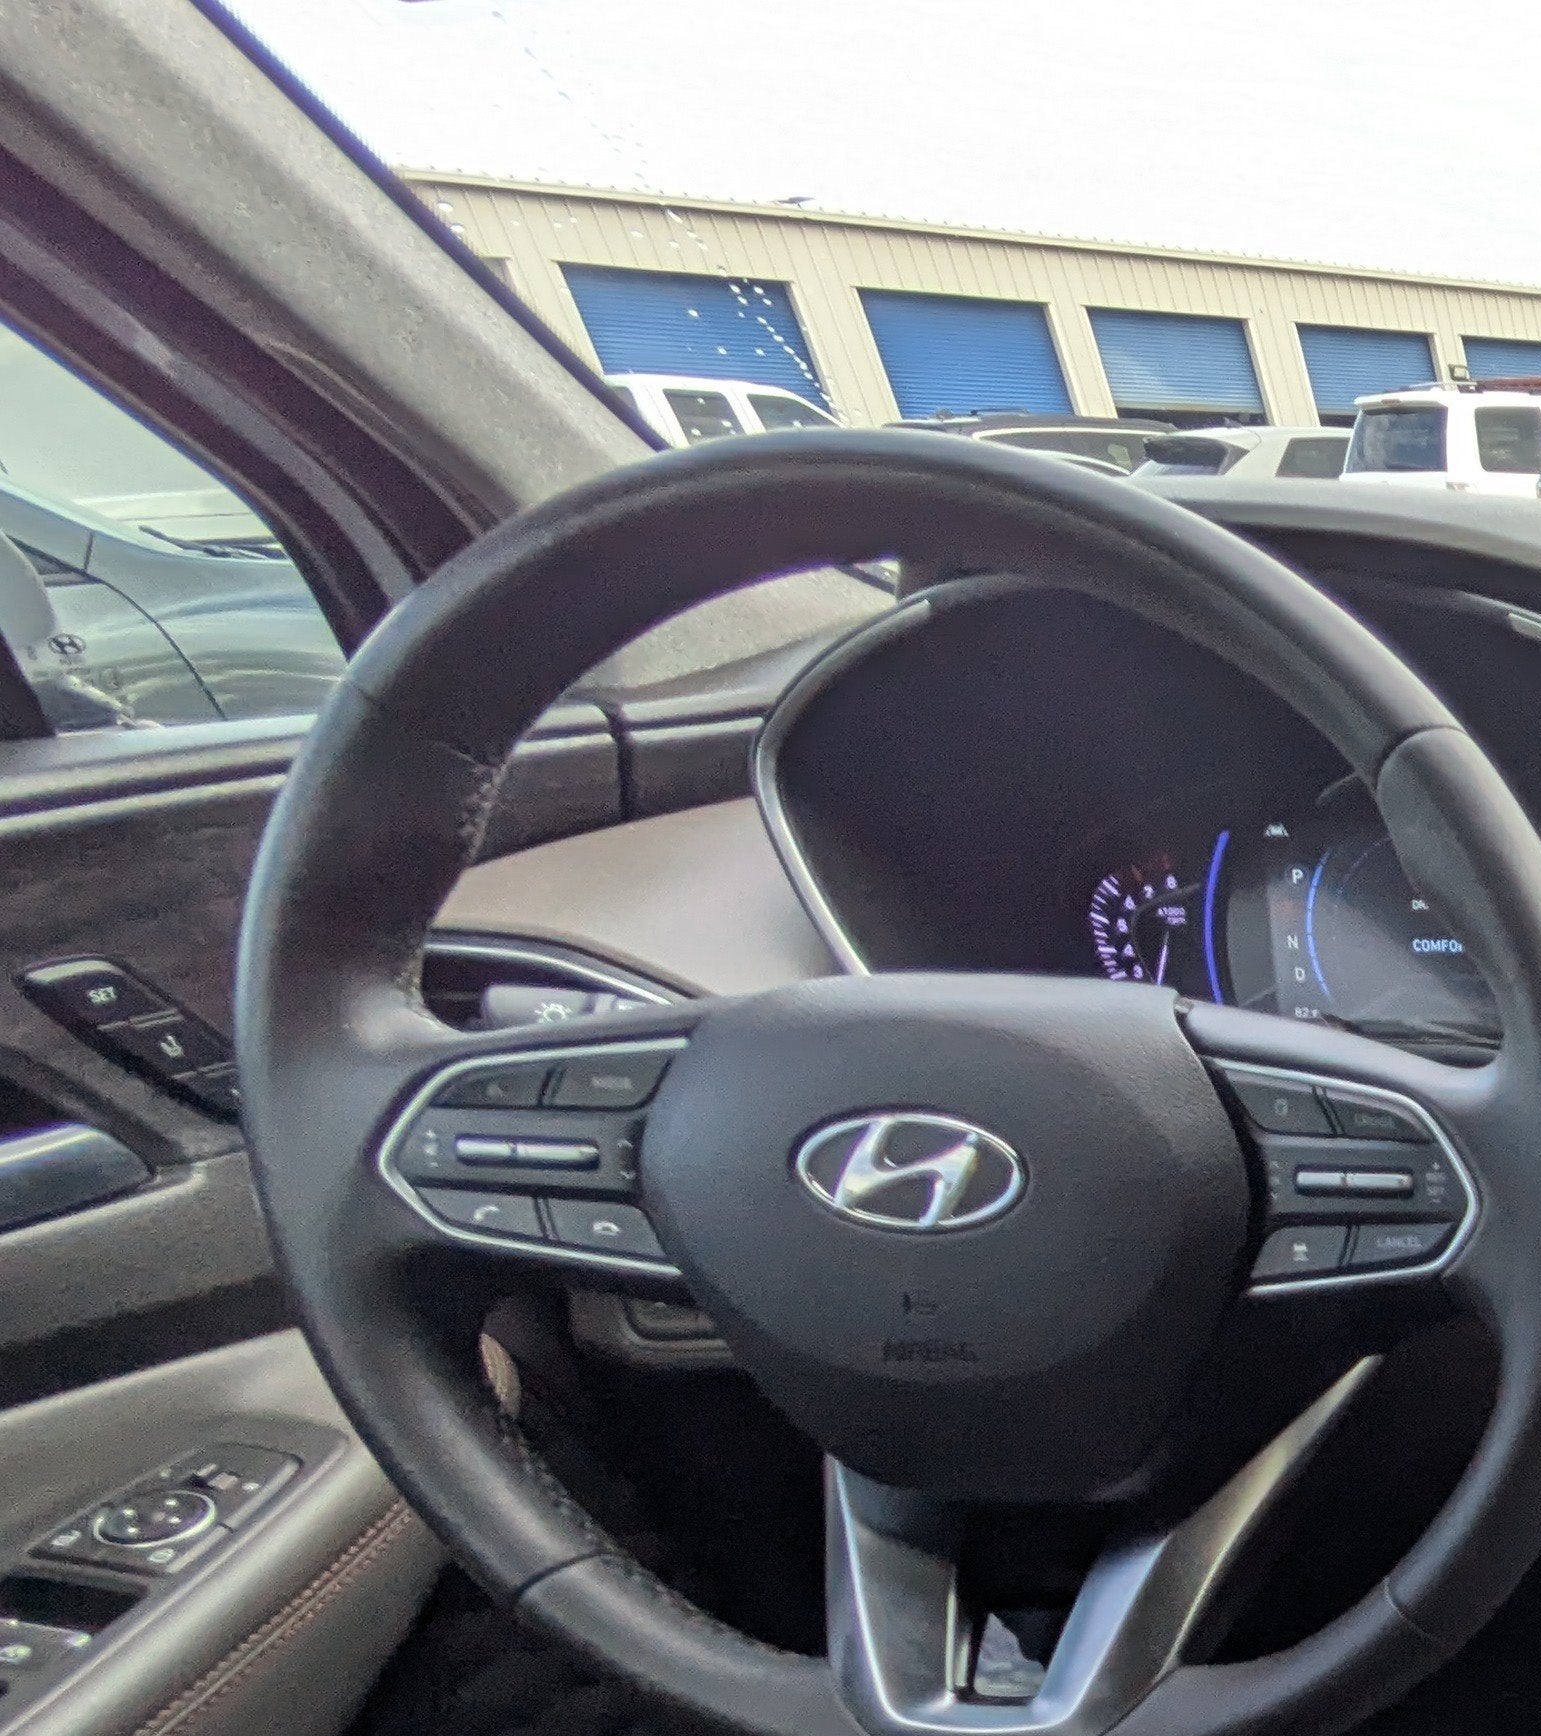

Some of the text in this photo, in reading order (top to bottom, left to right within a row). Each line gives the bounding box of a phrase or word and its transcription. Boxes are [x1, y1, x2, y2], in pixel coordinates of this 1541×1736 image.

[1291, 868, 1304, 884] P
[1286, 934, 1299, 950] N
[1123, 943, 1135, 958] 4
[1133, 964, 1144, 980] 3
[1295, 966, 1306, 982] D
[88, 986, 117, 1003] SET
